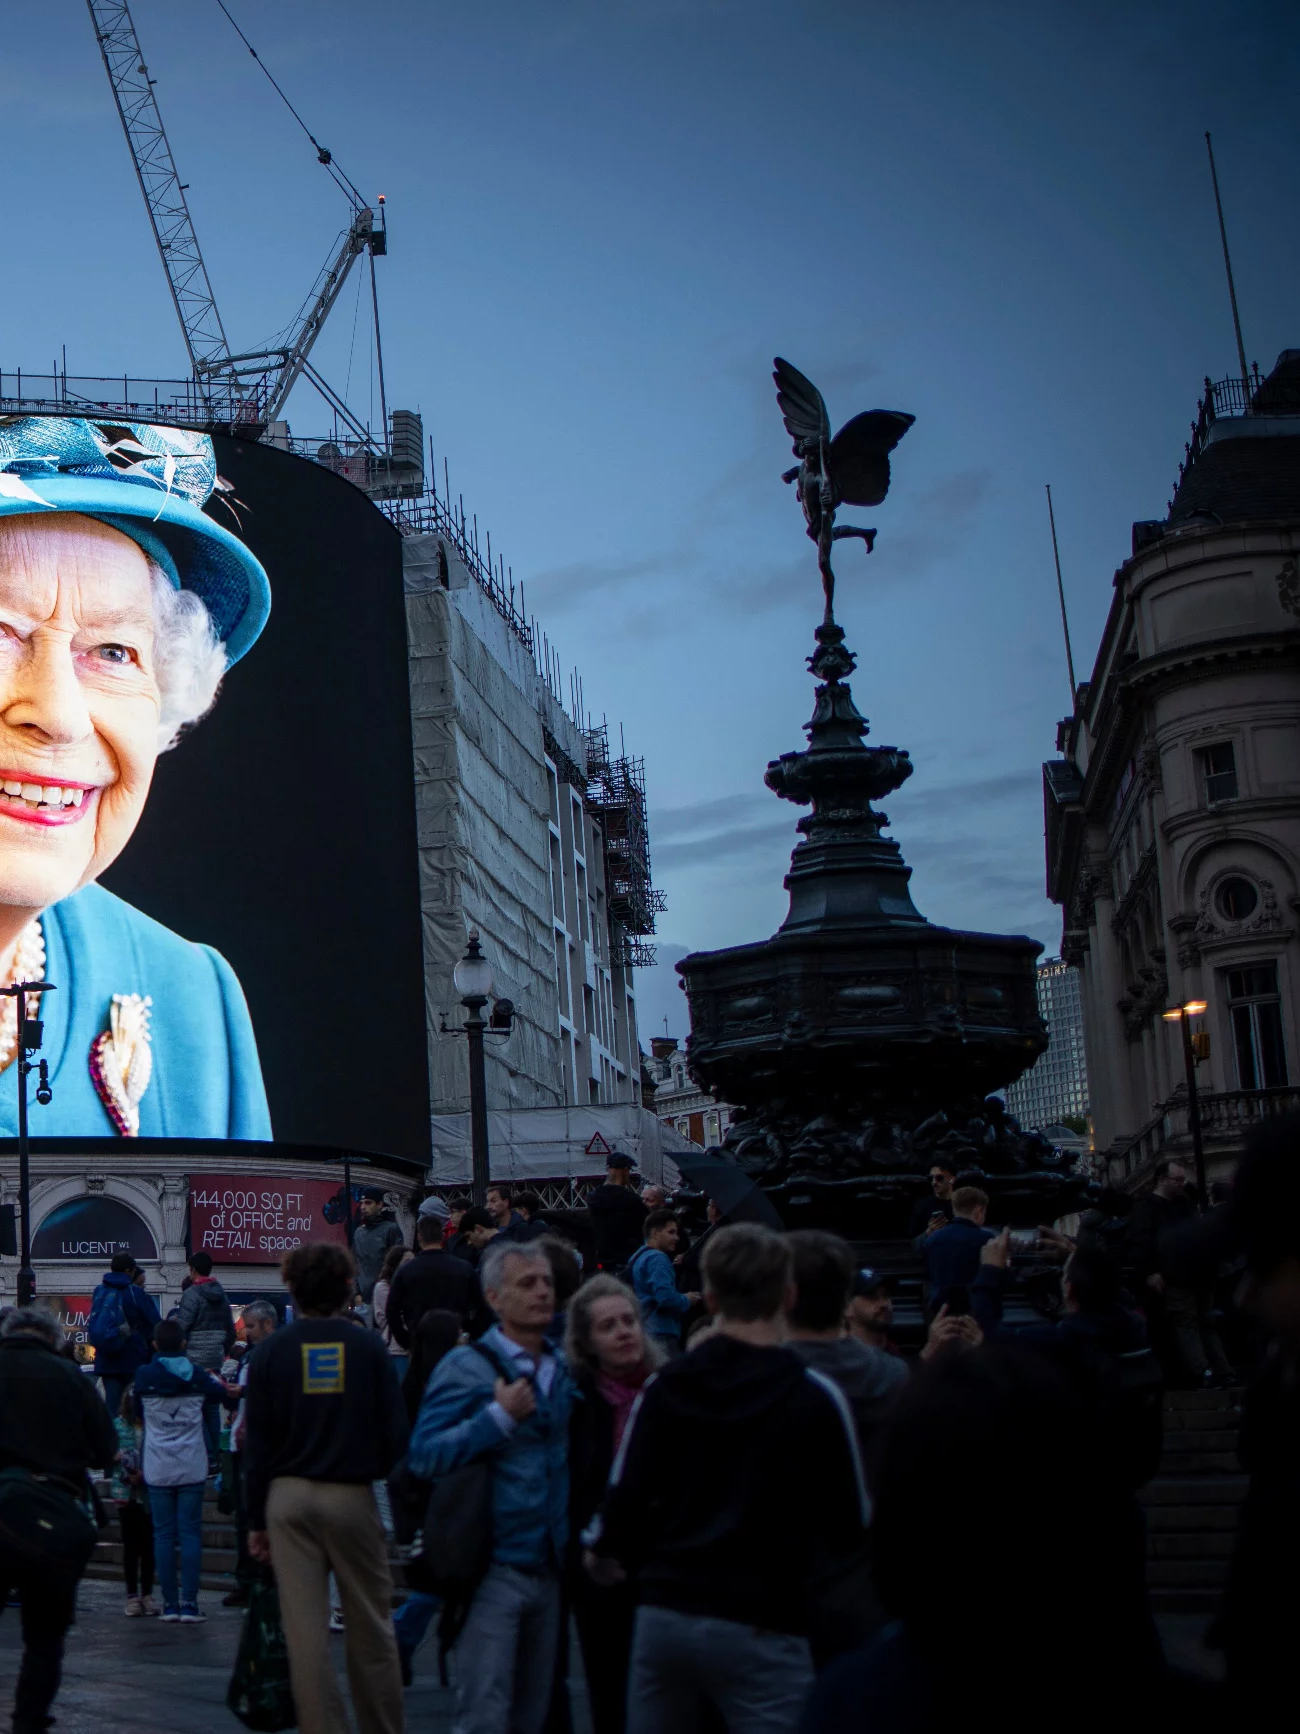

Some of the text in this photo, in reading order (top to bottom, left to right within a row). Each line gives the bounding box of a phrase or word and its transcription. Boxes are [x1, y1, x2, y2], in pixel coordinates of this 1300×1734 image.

[190, 1190, 304, 1211] 144,000 SQ FT
[210, 1211, 312, 1231] of OFFICE and
[61, 1241, 130, 1254] LUCENT W1
[202, 1230, 301, 1252] RETAIL space
